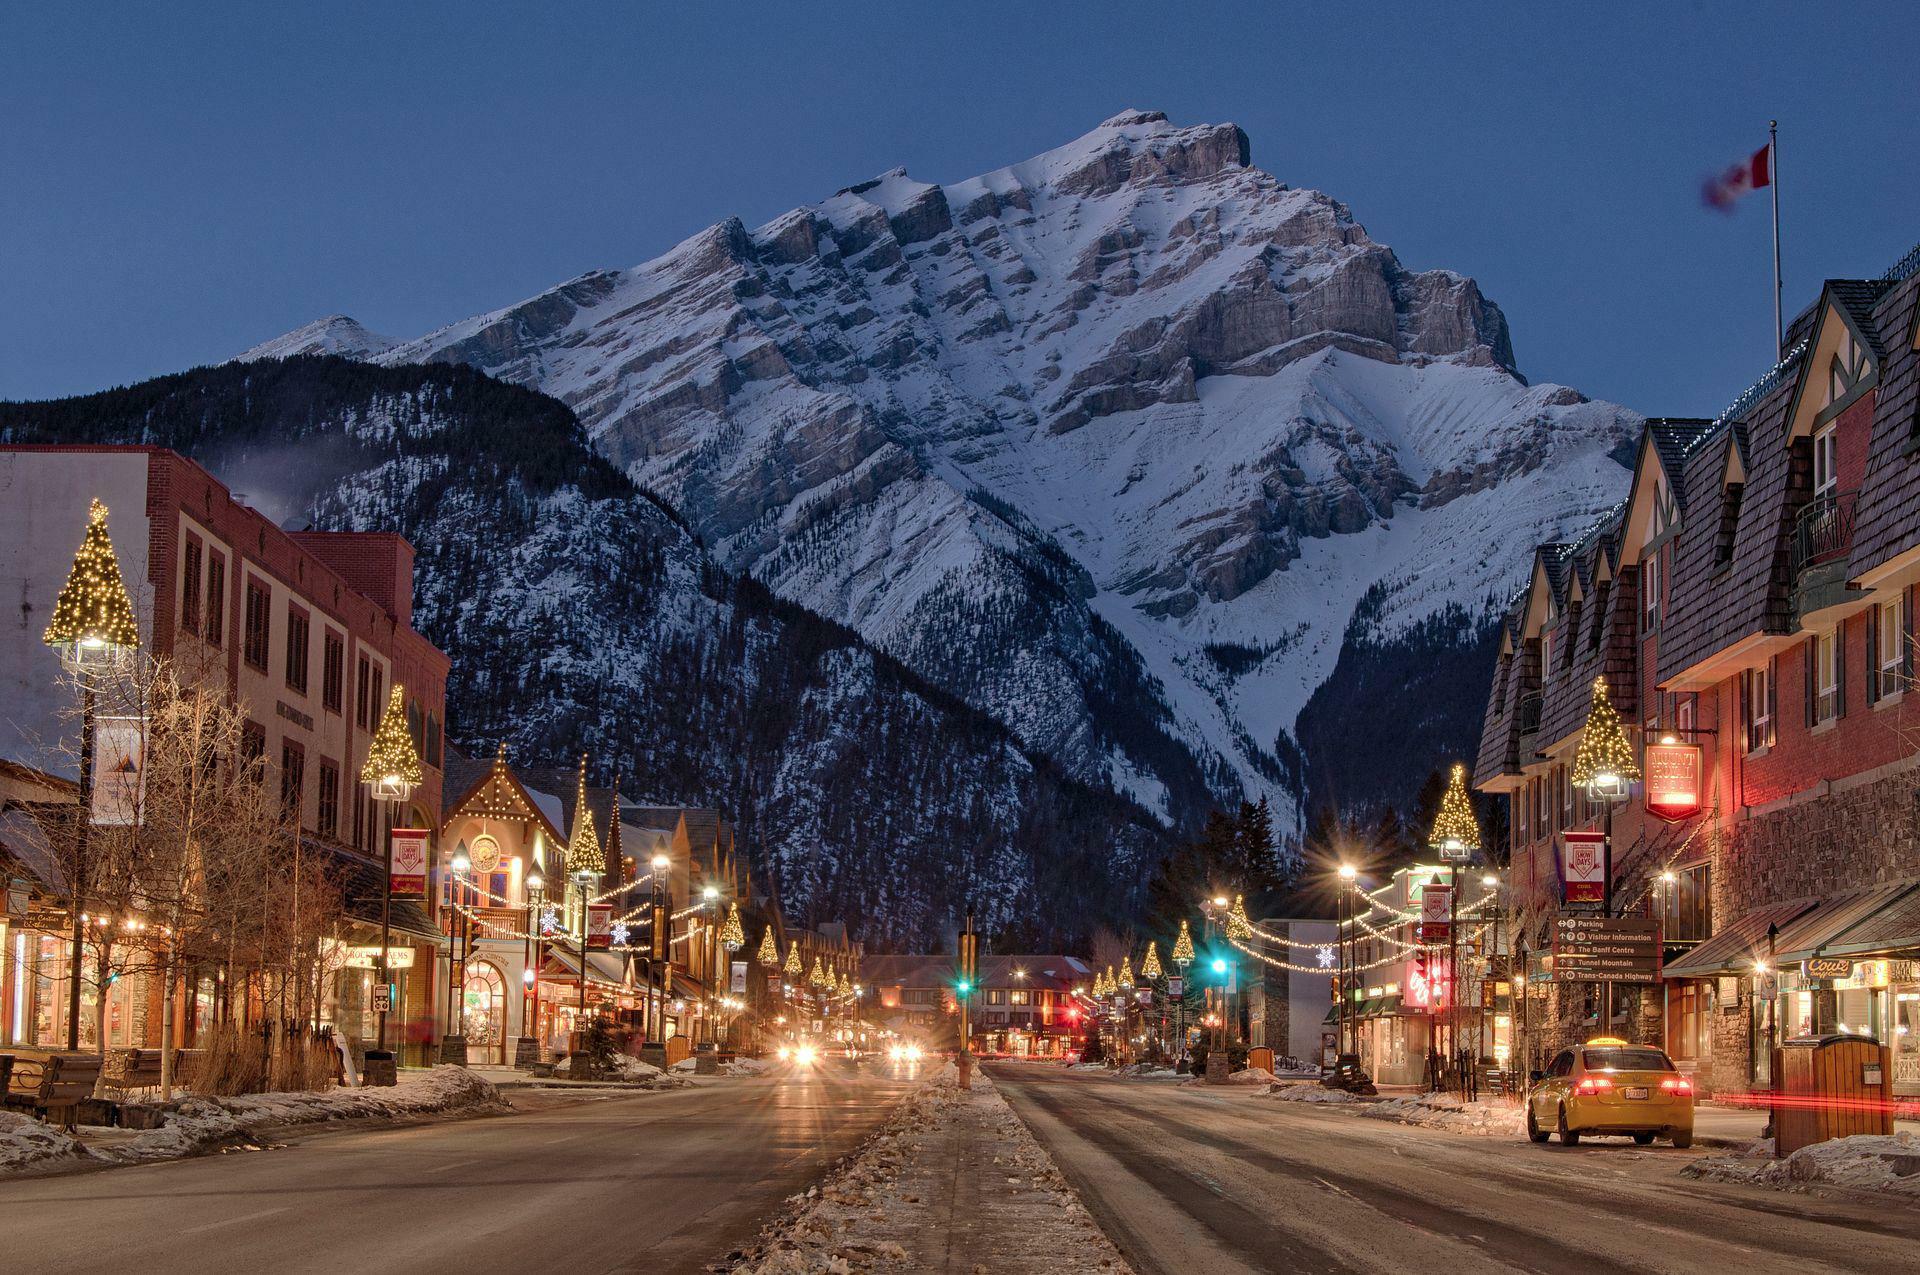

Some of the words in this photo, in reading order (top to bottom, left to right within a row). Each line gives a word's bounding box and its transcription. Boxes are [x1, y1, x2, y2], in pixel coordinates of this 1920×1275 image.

[1652, 752, 1695, 765] MOUNT
[1576, 858, 1591, 866] DAYS
[1578, 920, 1604, 929] Parking
[1612, 946, 1635, 954] Centre
[1624, 973, 1653, 981] Highway
